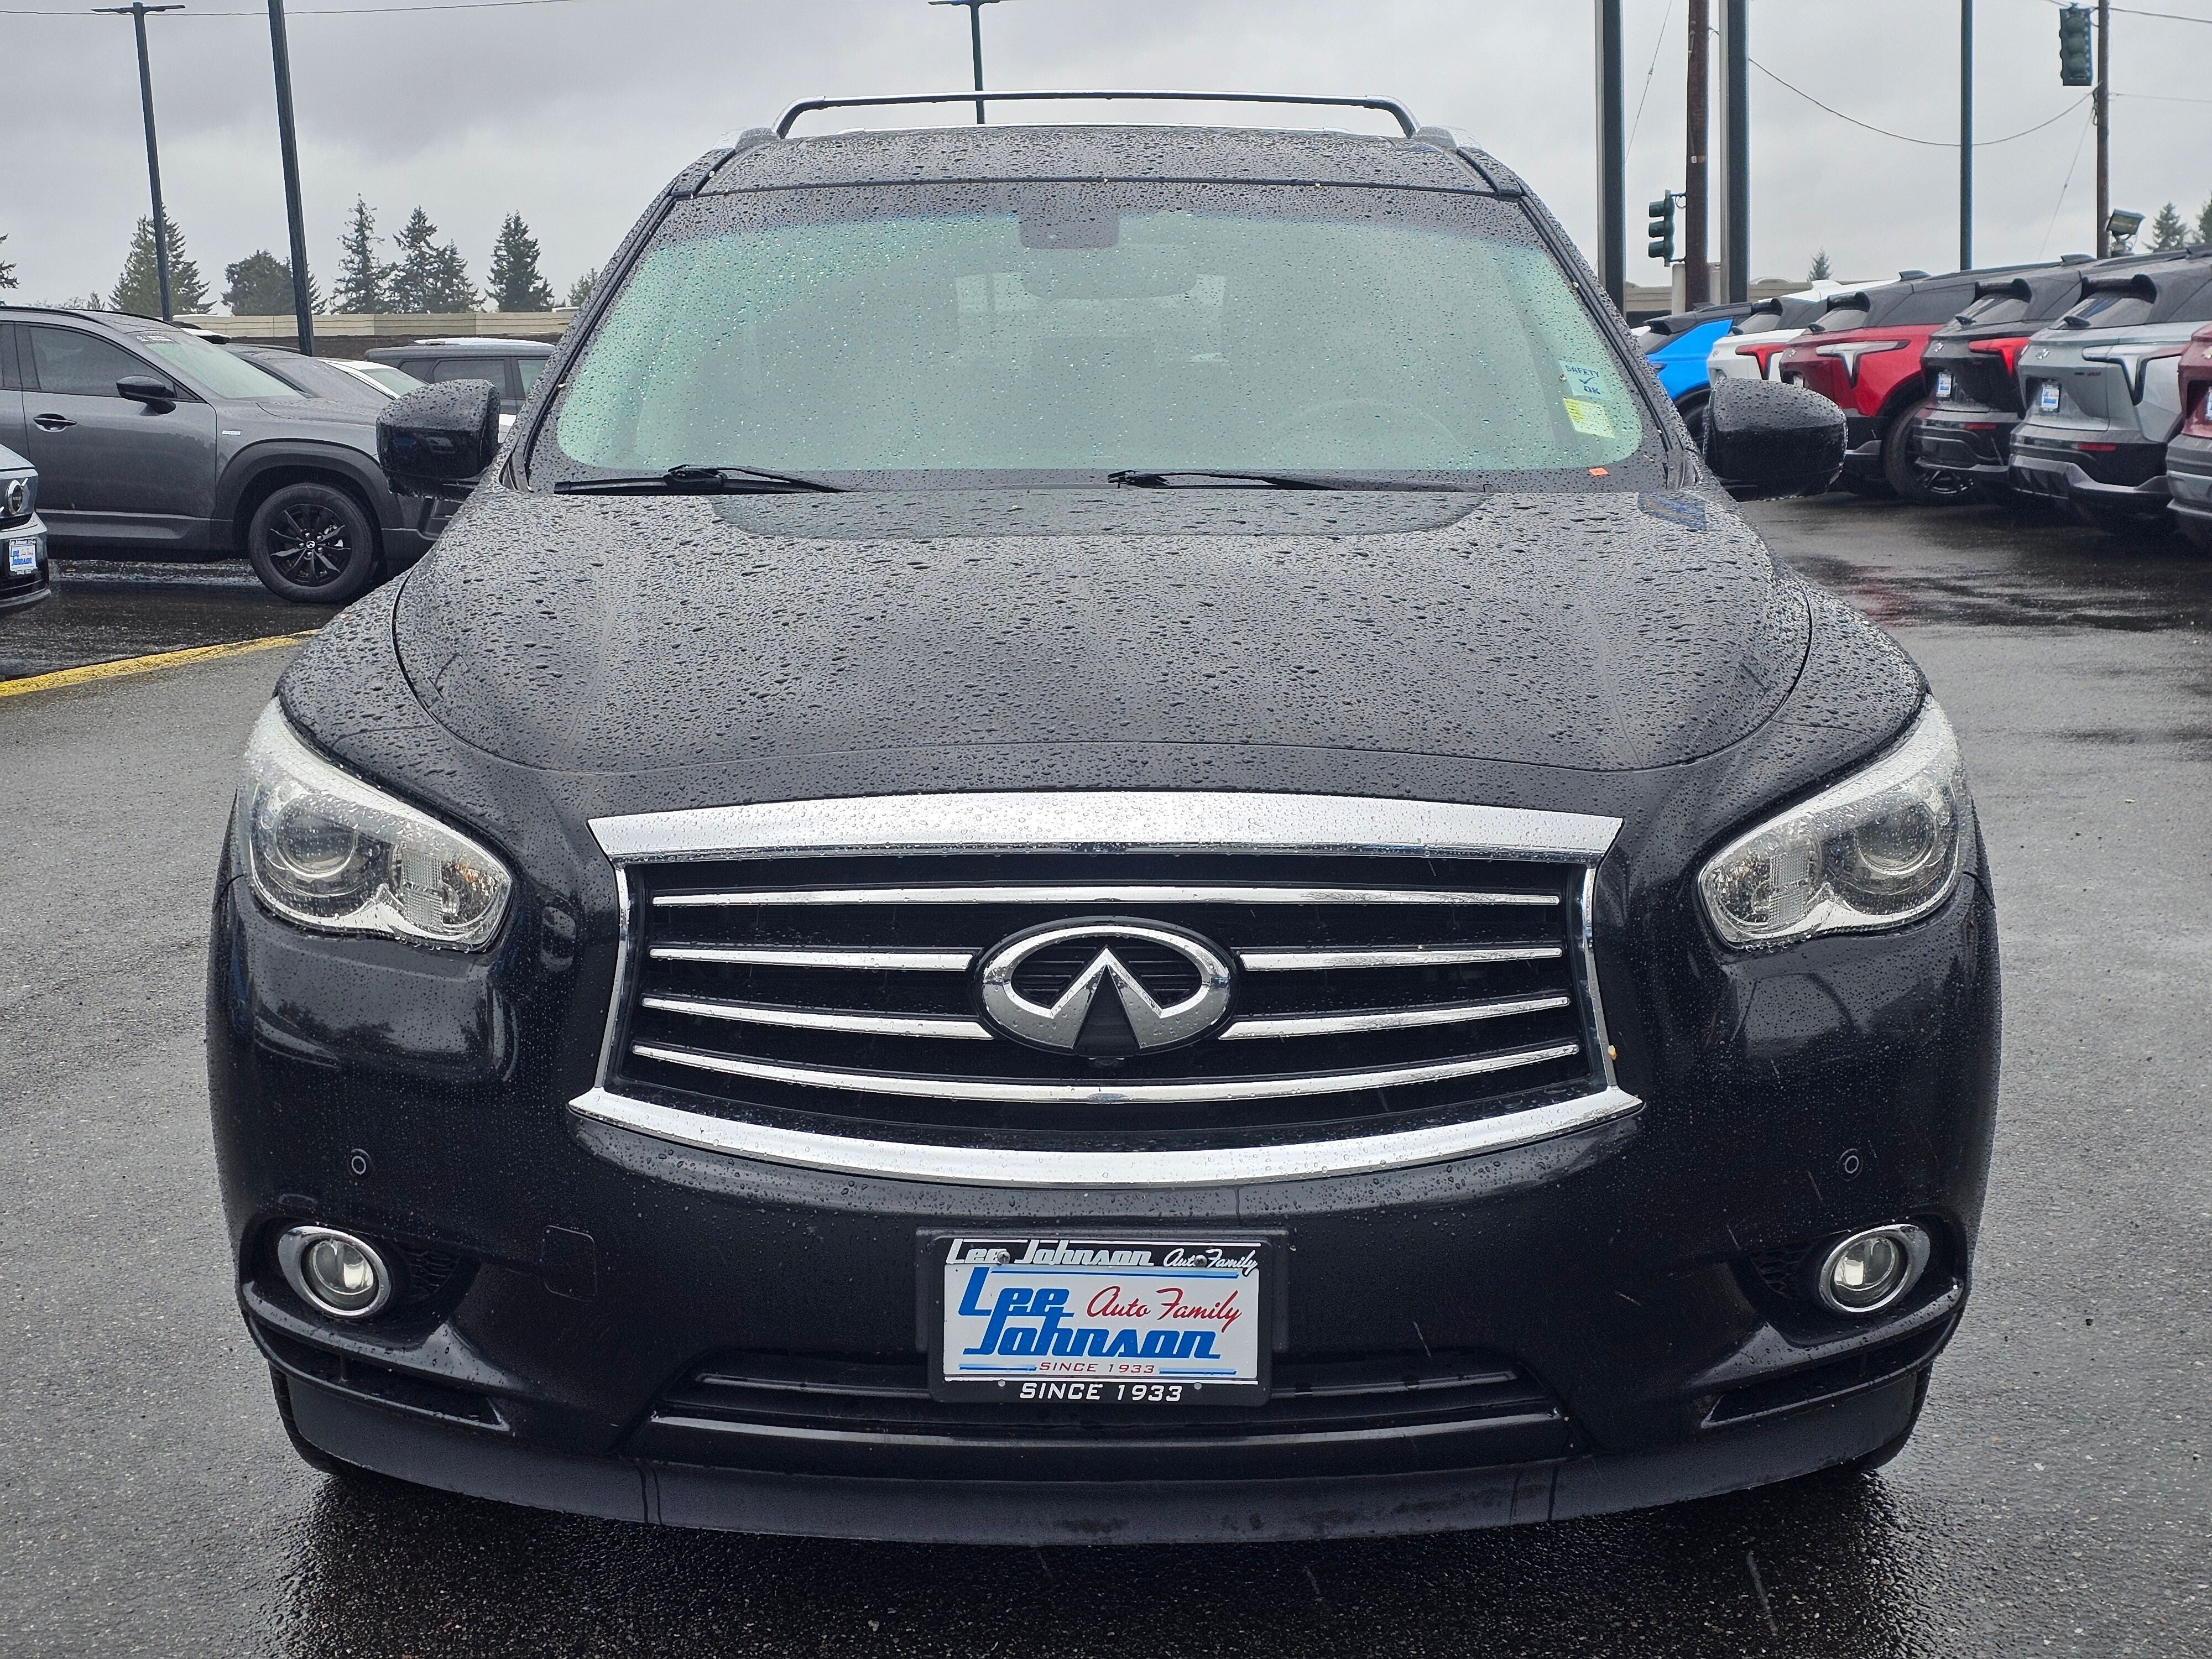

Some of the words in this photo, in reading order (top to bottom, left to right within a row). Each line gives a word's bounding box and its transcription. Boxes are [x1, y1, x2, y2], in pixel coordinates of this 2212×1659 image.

[1564, 365, 1599, 377] SAFETY
[1583, 385, 1601, 395] OK
[1014, 1239, 1155, 1266] Johnson
[1163, 1248, 1201, 1267] Aut
[1205, 1248, 1259, 1276] Family
[958, 1266, 1075, 1317] Lee
[1086, 1286, 1151, 1317] Auto
[1155, 1287, 1243, 1333] Family
[962, 1314, 1221, 1359] Johnson
[1039, 1361, 1099, 1373] SINCE
[1108, 1363, 1155, 1374] 1933
[1019, 1382, 1104, 1400] SINCE
[1117, 1384, 1183, 1402] 1933
